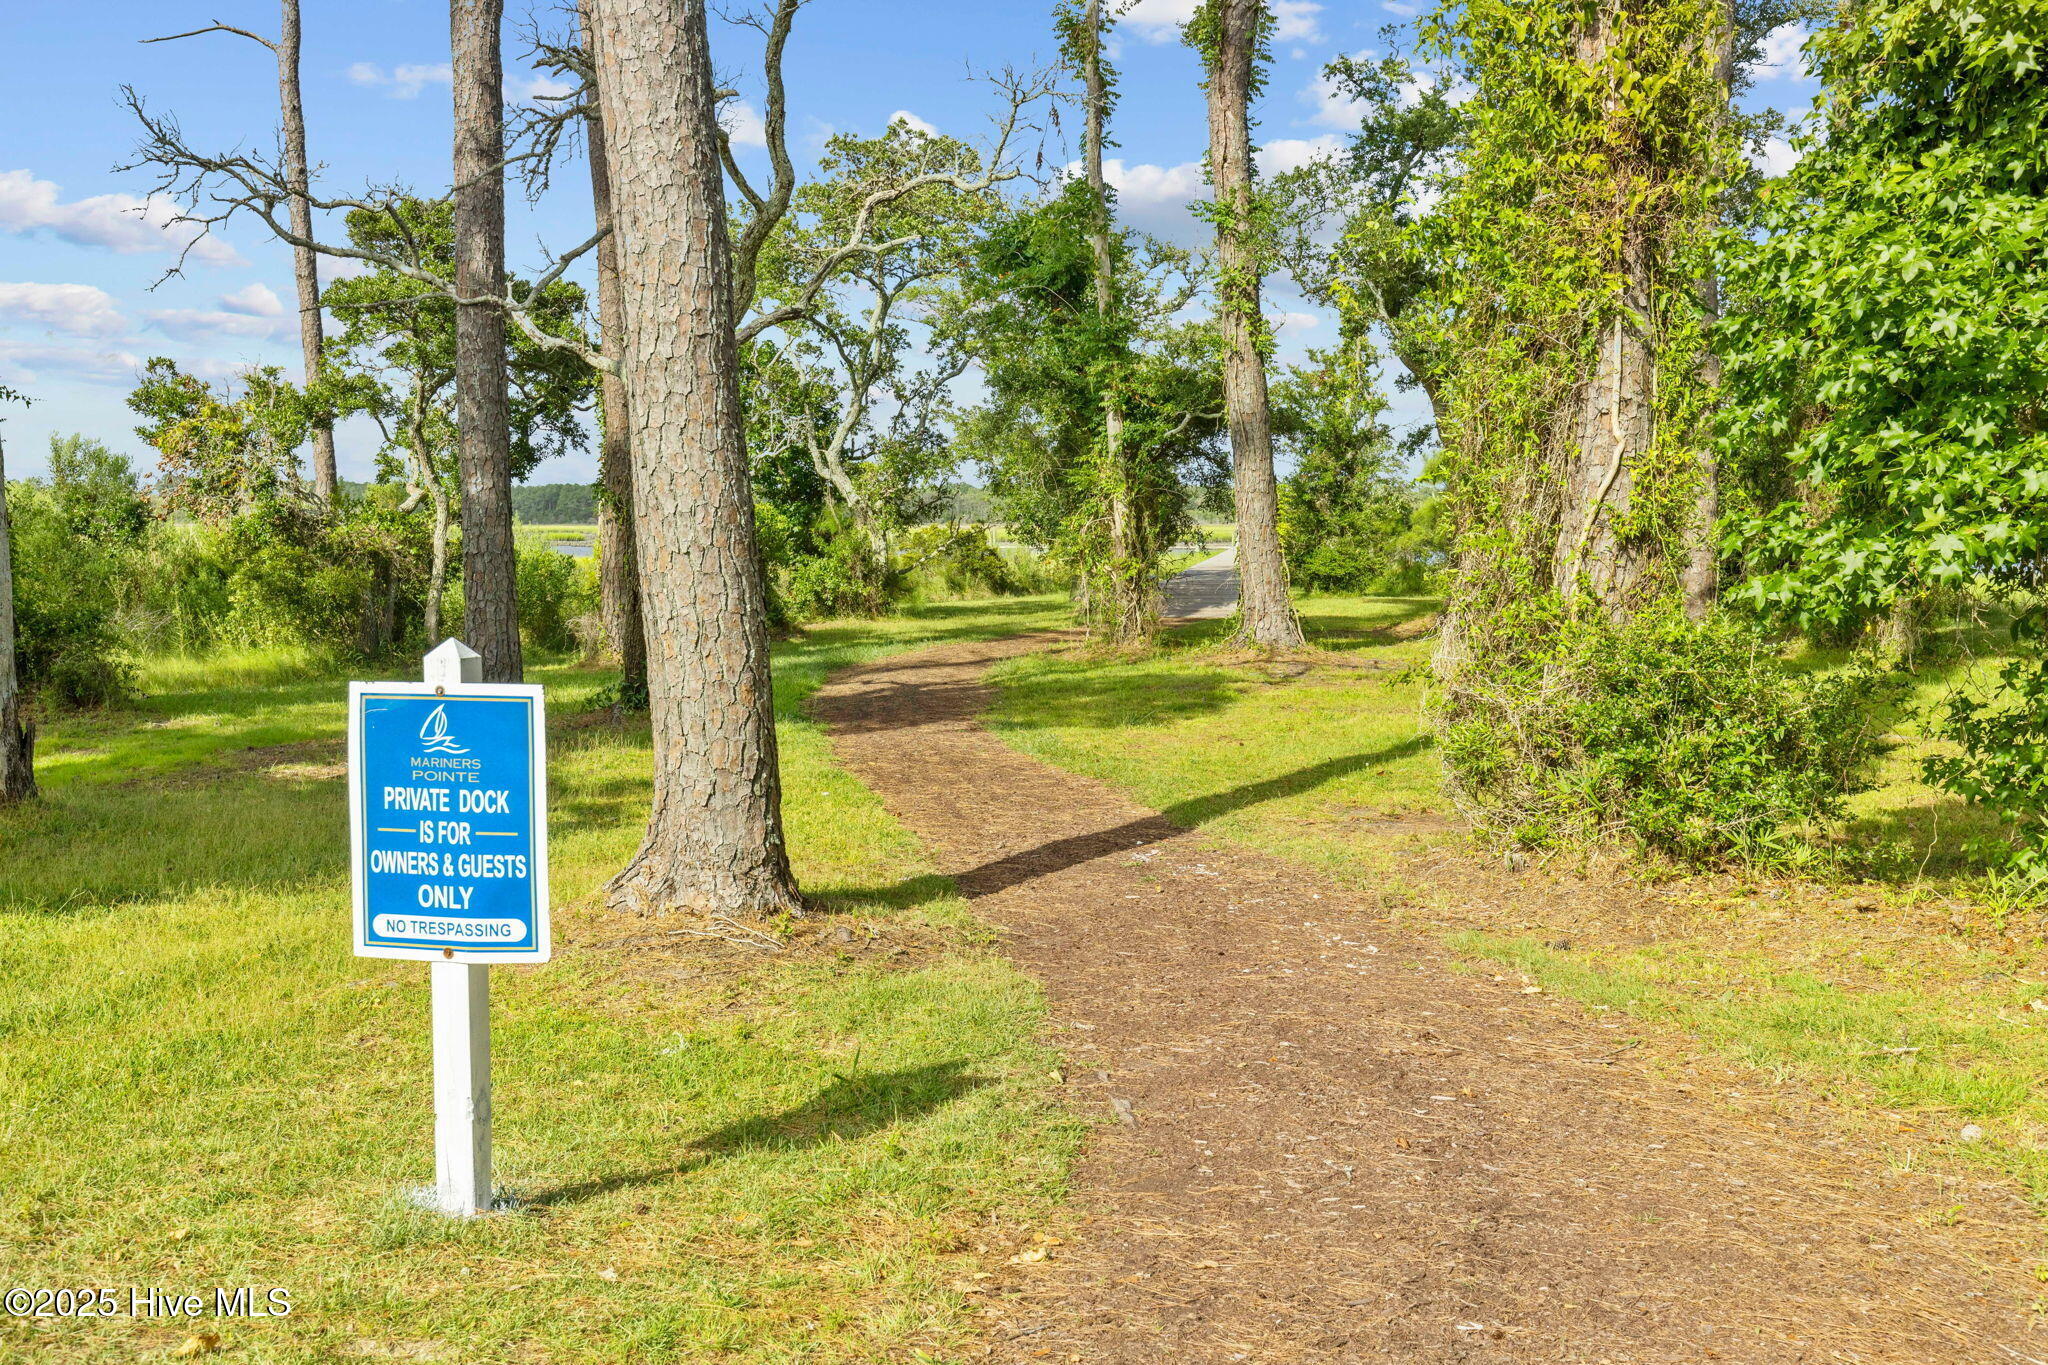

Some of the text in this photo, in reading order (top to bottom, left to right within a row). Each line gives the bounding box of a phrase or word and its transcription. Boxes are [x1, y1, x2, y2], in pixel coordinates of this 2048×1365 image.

[410, 757, 481, 769] MARINERS
[412, 770, 480, 783] POINTE
[384, 787, 510, 814] PRIVATE DOCK
[419, 820, 471, 845] IS FOR
[370, 850, 527, 878] OWNERS & GUESTS
[418, 884, 474, 910] ONLY
[386, 919, 512, 937] NO TRESPASSING
